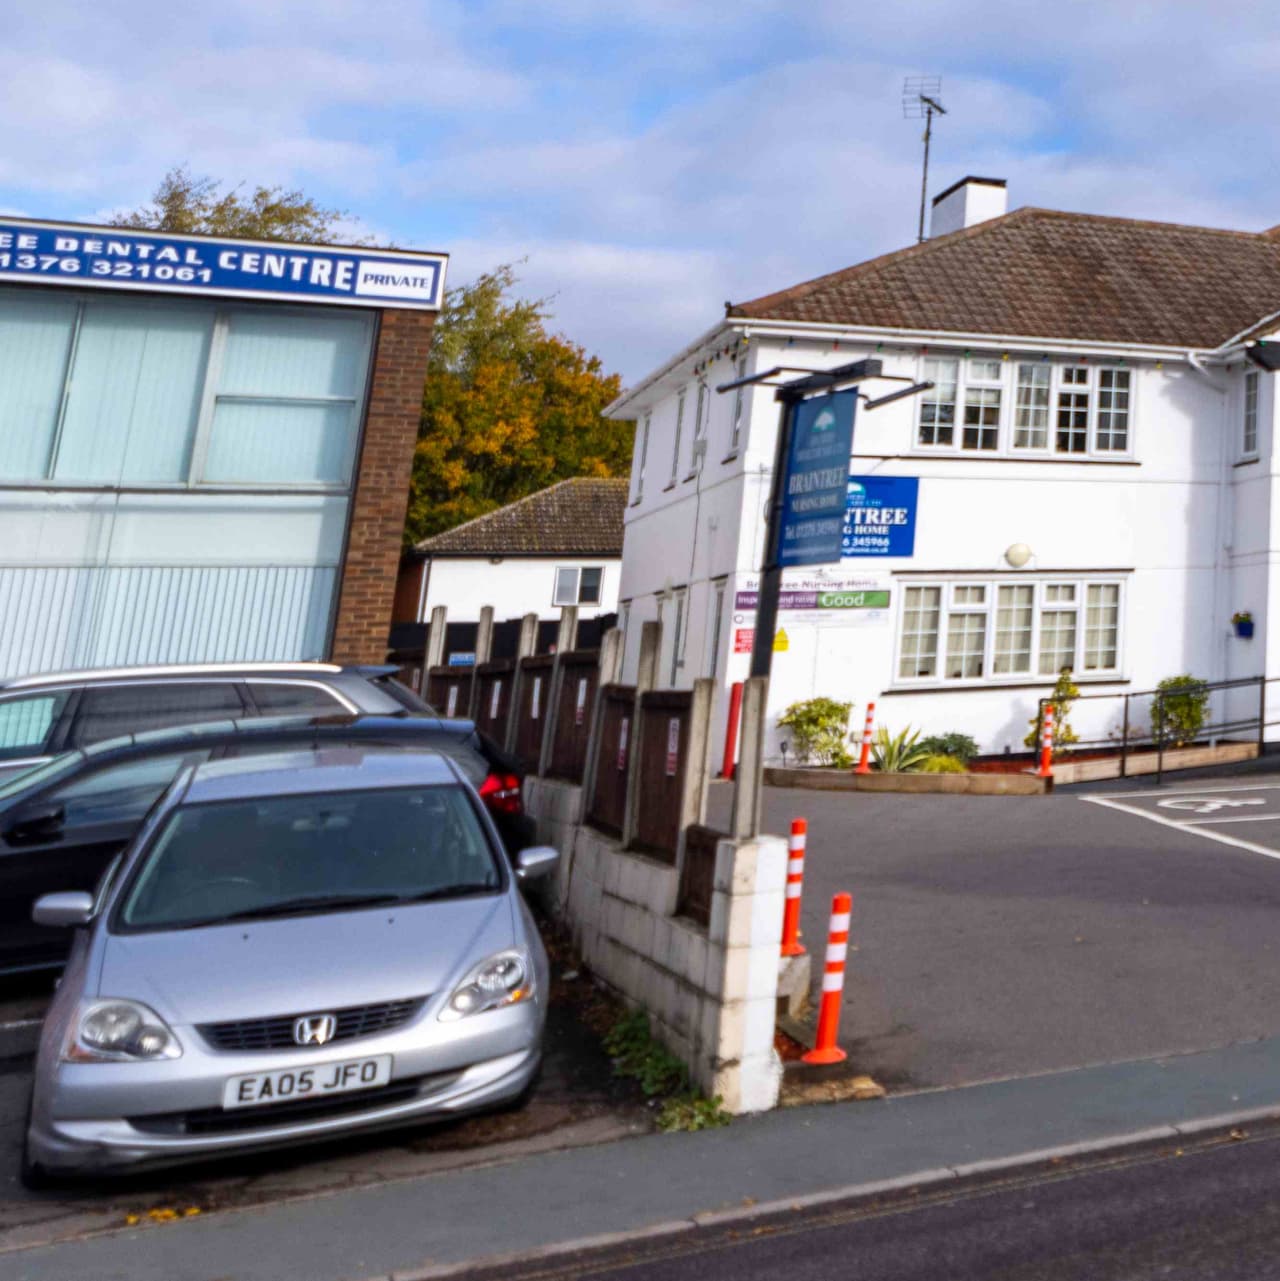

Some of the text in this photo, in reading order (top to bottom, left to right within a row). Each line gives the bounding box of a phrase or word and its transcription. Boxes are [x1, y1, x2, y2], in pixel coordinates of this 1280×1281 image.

[55, 236, 204, 265] DENTAL
[218, 250, 354, 291] CENTRE
[92, 260, 212, 283] 321061
[363, 272, 428, 289] PRIVATE
[789, 466, 845, 494] BRAINTREE
[855, 525, 889, 535] HOME
[852, 536, 890, 547] 345966
[821, 592, 865, 607] Good
[238, 1060, 377, 1102] EA05 JFO
